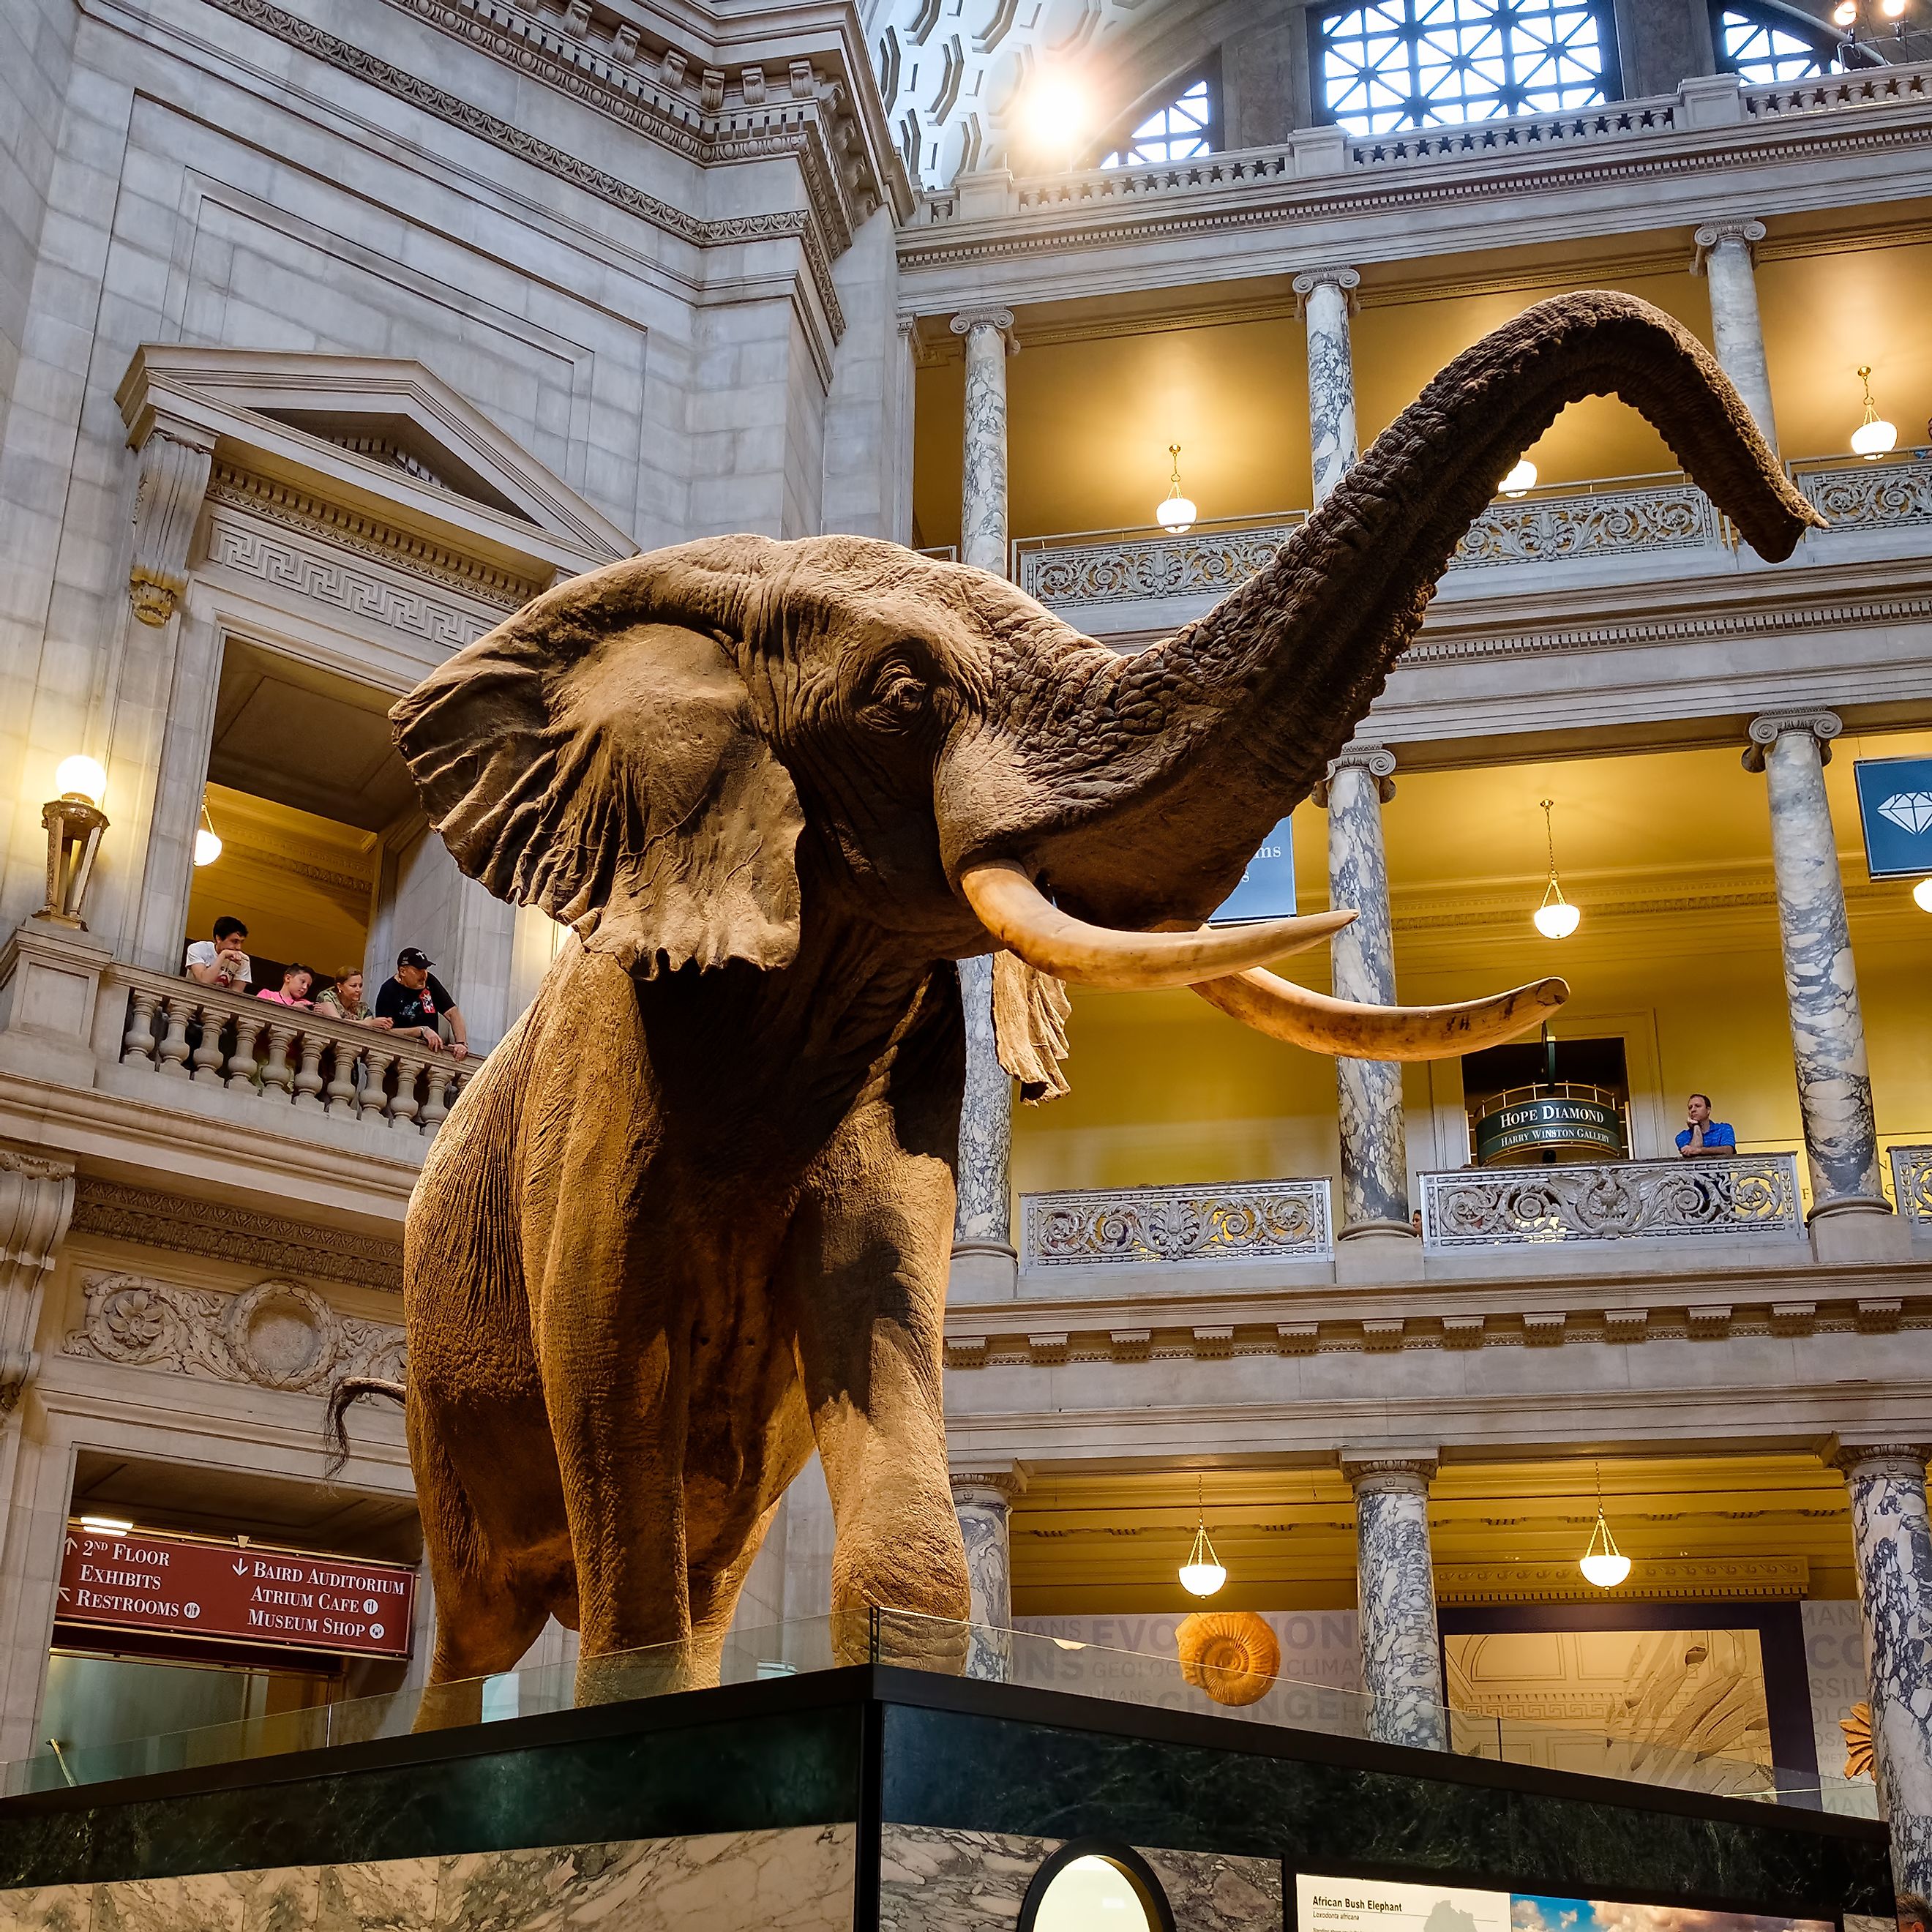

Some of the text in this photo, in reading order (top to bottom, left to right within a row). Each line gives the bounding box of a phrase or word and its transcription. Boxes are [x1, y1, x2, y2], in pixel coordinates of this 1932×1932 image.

[1500, 1105, 1604, 1128] HOPE DIAMOND
[1501, 1128, 1610, 1147] HARRY WINSTON GALLERY
[111, 1543, 170, 1566] FLOOR
[79, 1564, 162, 1590] EXHIBITS
[252, 1560, 405, 1595] BAIRD AUDITORIUM
[76, 1589, 179, 1617] RESTROOMS
[250, 1585, 359, 1613] ATRIUM CAFE
[247, 1609, 366, 1637] MUSEUM SHOP
[1313, 1895, 1402, 1913] African Bush Elephant
